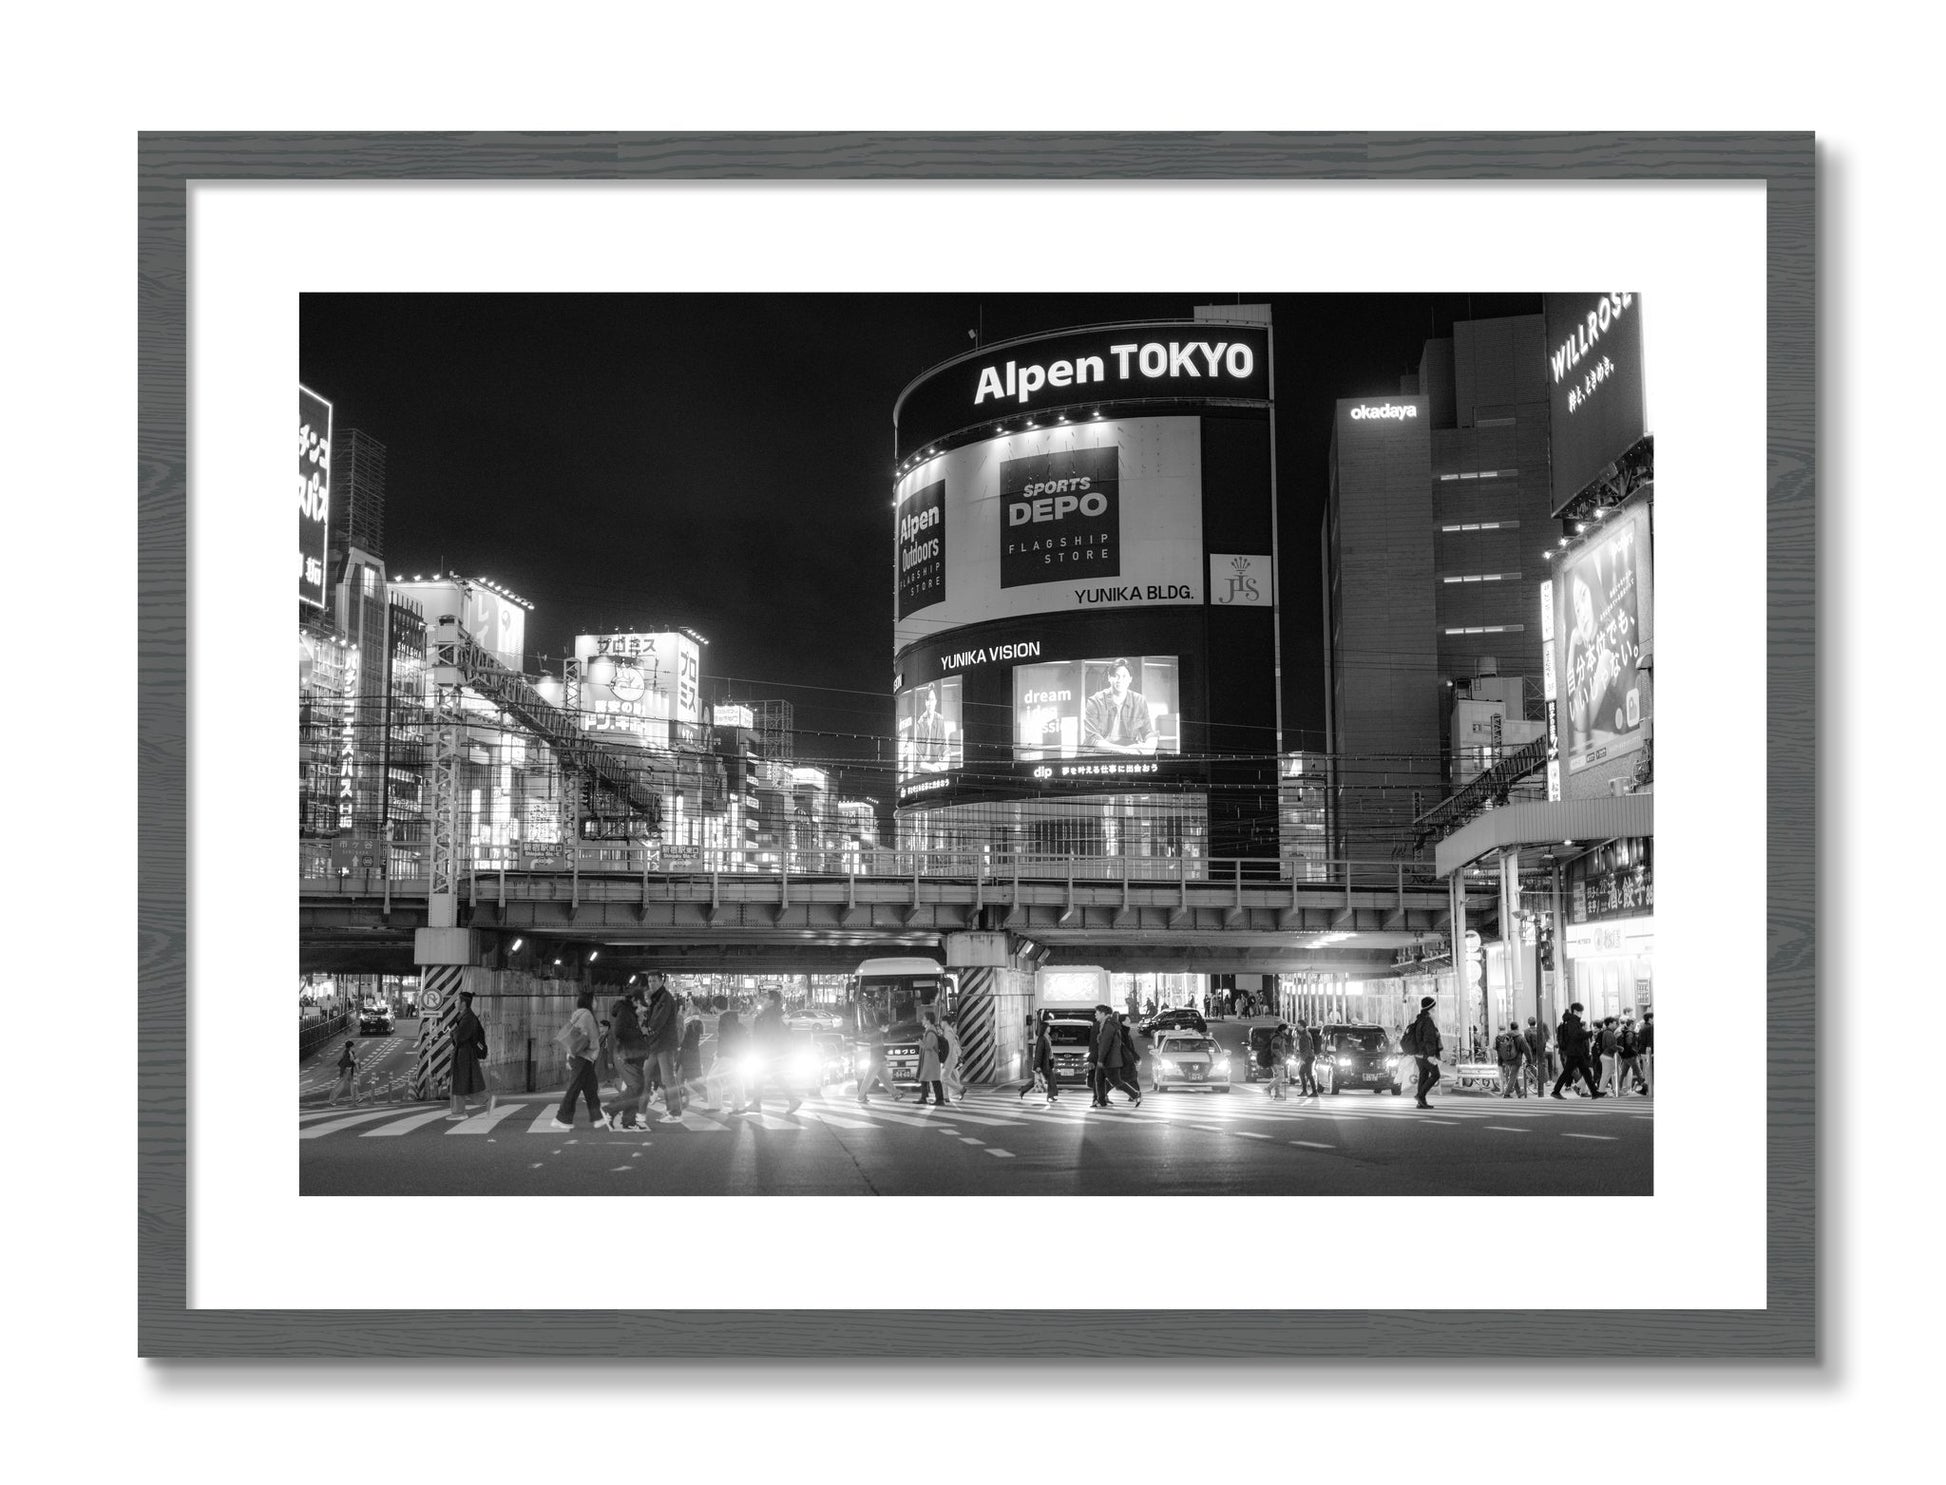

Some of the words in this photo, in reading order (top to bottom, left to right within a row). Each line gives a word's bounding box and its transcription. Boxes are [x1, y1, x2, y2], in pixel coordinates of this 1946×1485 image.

[974, 355, 1104, 404] Alpen
[1110, 341, 1254, 380] TOKYO
[1350, 402, 1418, 420] okadaya
[1023, 476, 1091, 498] SPORTS
[1009, 492, 1108, 527] DEPO
[900, 506, 940, 544] Alpen
[1008, 533, 1110, 554] FLAGSHIP
[902, 538, 939, 572] Outdoors
[1044, 548, 1109, 564] STORE
[911, 576, 940, 596] STORE
[1074, 586, 1143, 604] YUNIKA
[1147, 584, 1195, 601] BLDG.
[597, 636, 656, 655] プロミス
[941, 649, 987, 671] YUNIKA
[989, 641, 1041, 661] VISION
[1024, 689, 1072, 704] dream
[1033, 766, 1053, 779] dip
